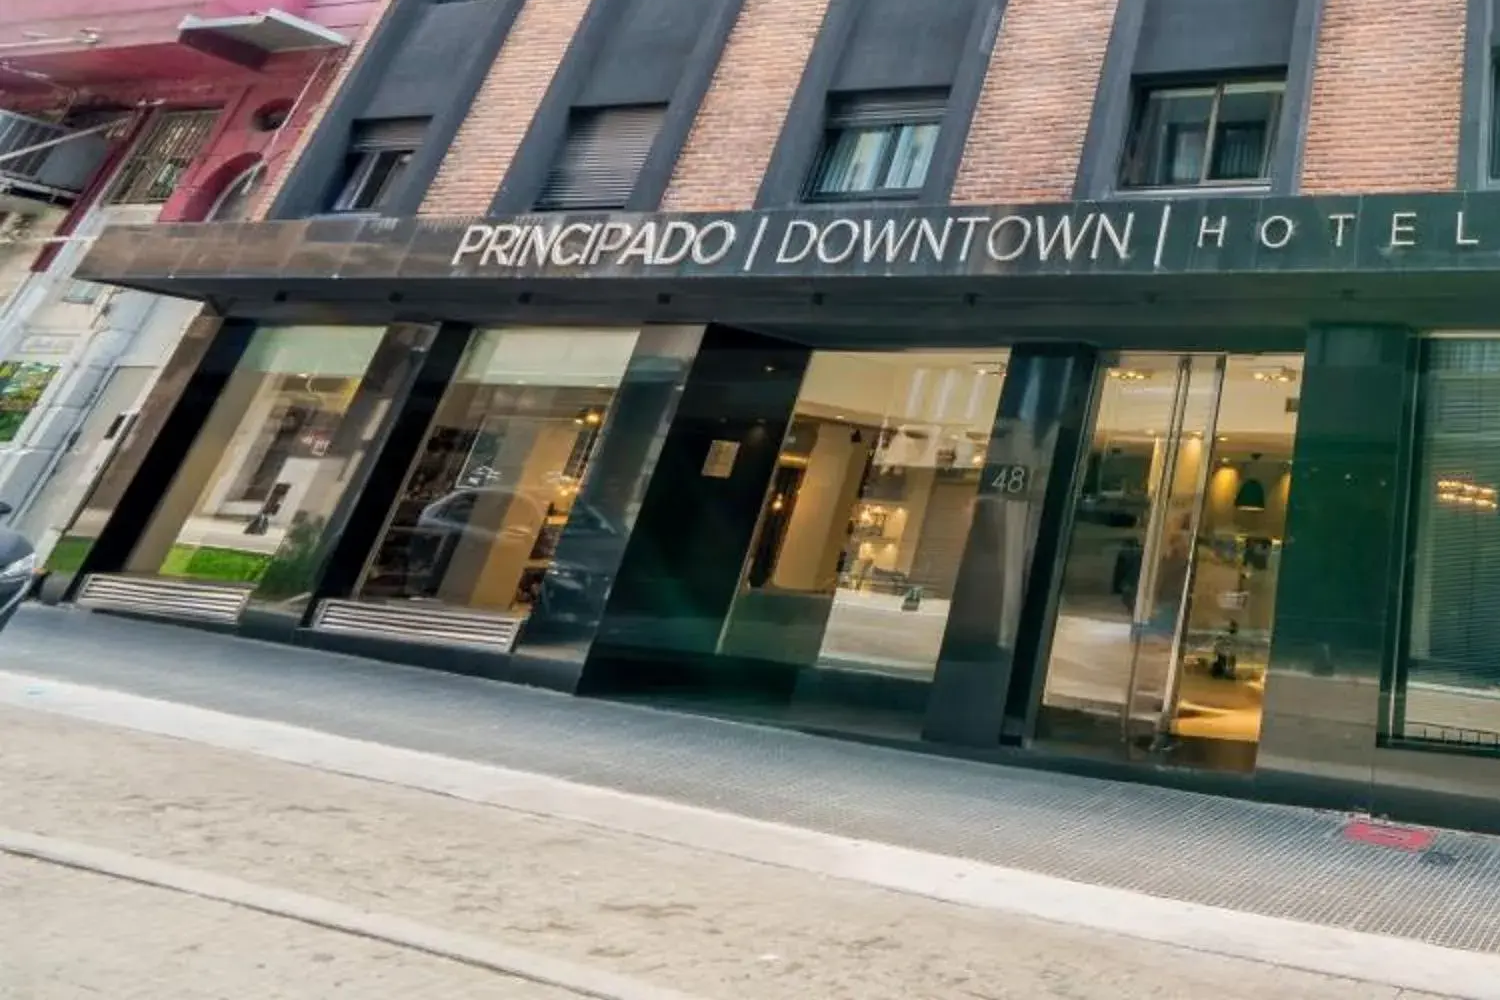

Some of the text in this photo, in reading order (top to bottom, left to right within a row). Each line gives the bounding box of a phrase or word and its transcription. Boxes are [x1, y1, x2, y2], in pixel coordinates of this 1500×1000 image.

[451, 211, 1479, 267] PRINCIPADO DOWNTOWN HOTEL
[991, 466, 1025, 494] 48
